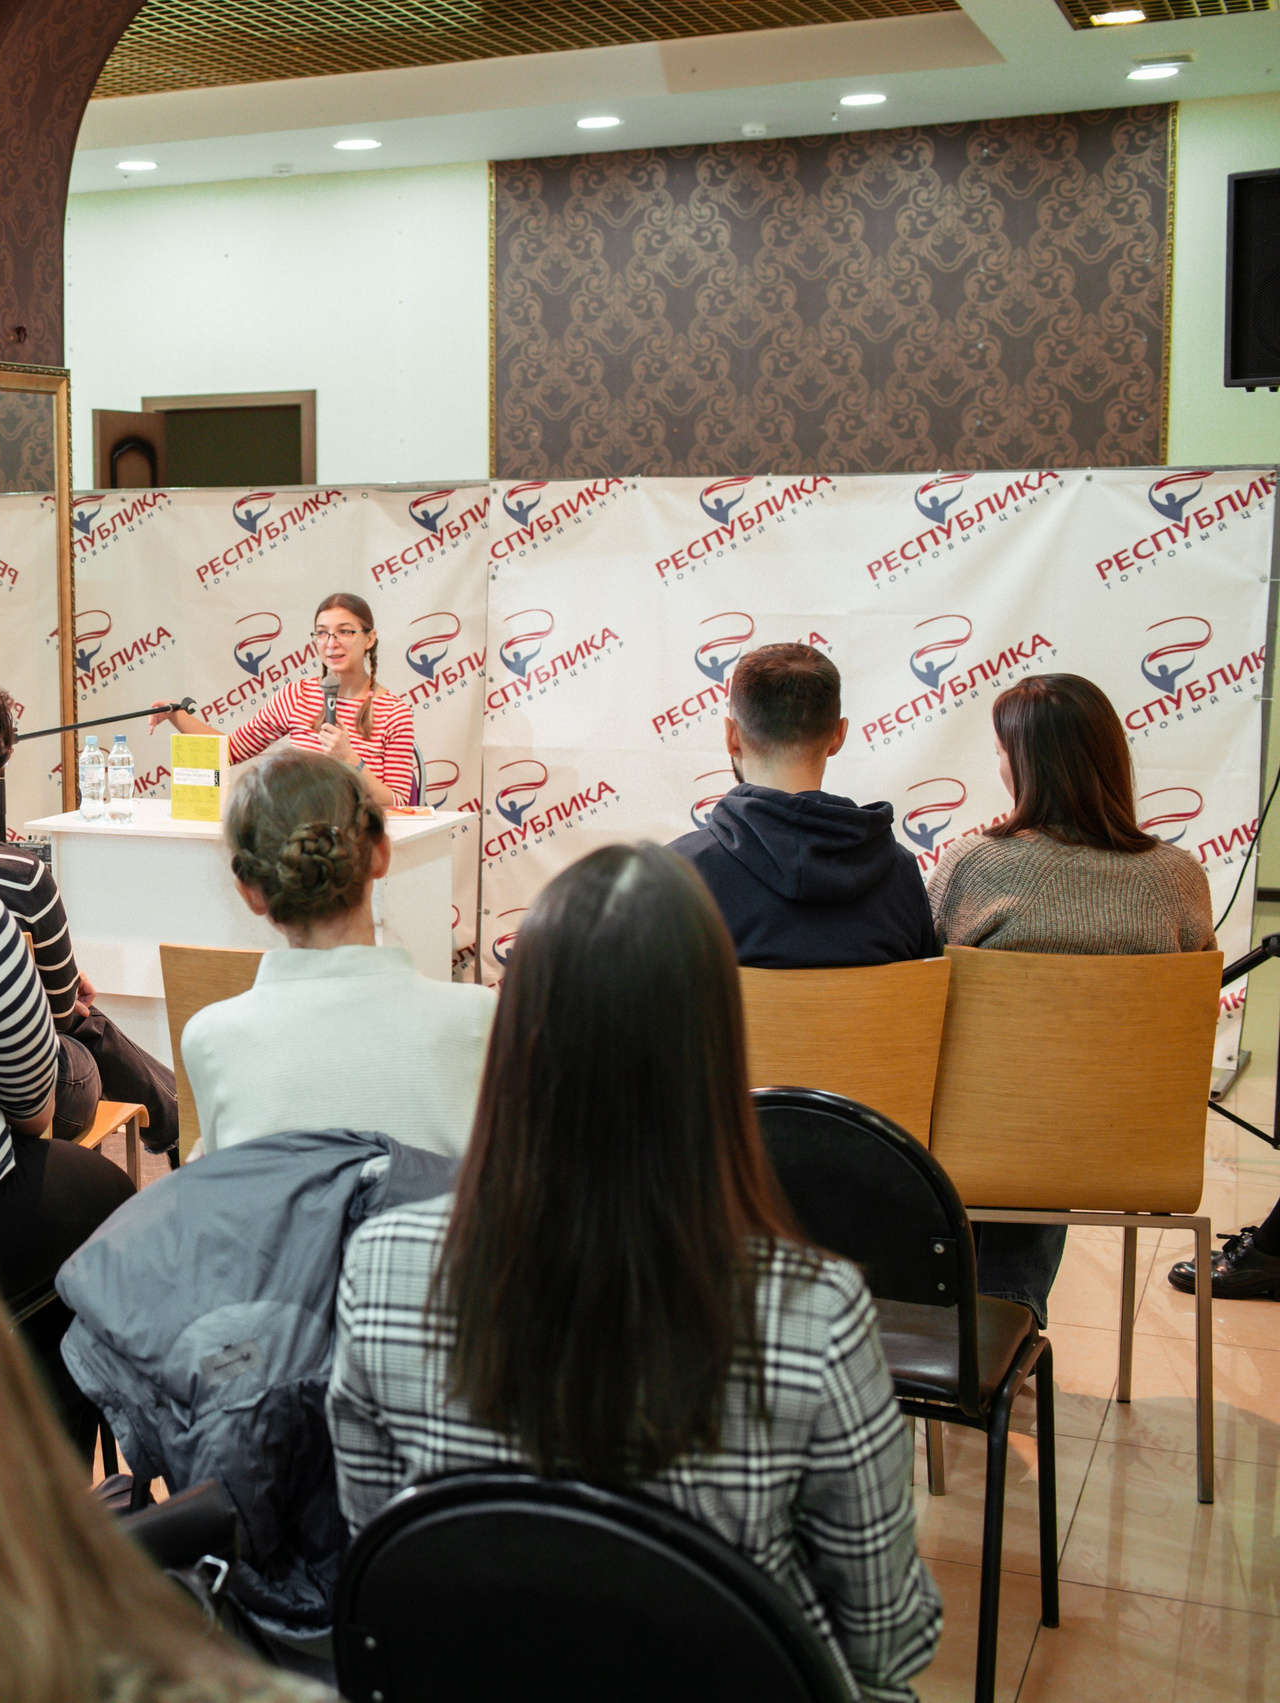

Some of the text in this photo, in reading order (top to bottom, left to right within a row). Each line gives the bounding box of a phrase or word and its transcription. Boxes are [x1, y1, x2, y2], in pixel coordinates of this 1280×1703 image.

[72, 493, 168, 558] ПУБЛИКА
[80, 500, 172, 563] ОВЫЙ ЦЕНТР
[196, 491, 342, 583] РЕСПУБЛИКА
[203, 496, 348, 591] ТОРГОВЫЙ ЦЕНТР
[371, 497, 490, 583] РЕСПУБЛИ
[378, 532, 472, 590] ТОРГОВЫЙ
[488, 479, 623, 566] СПУБЛИКА
[493, 485, 629, 571] РГОВЫЙ ЦЕНТР
[655, 476, 832, 579] РЕСПУБЛИКА
[663, 484, 838, 588] ТОРГОВЫЙ ЦЕНТР
[866, 471, 1059, 581] РЕСПУБЛИКА
[875, 480, 1065, 590] ТОРГОВЫЙ ЦЕНТР
[1095, 472, 1276, 581] РЕСПУБЛИК
[1104, 522, 1227, 590] ТОРГОВЫЙ
[81, 639, 176, 700] ОВЫЙ ЦЕНТР
[200, 641, 319, 723] РЕСПУБЛИ
[209, 677, 291, 727] ОРГОВЫЙ
[423, 680, 467, 709] ОВЫЙ
[483, 627, 619, 715] СПУБЛИКА
[490, 641, 624, 722] РГОВЫЙ ЦЕНТР
[861, 633, 1053, 743] РЕСПУБЛИКА
[870, 649, 1058, 752] ТОРГОВЫЙ ЦЕНТР
[1125, 644, 1266, 730] СПУБЛИК
[660, 702, 730, 743] ТОРГО
[1128, 694, 1219, 744] РГОВЫЙ
[481, 781, 616, 863] СПУБЛИКА
[488, 828, 556, 869] РГОВЫЙ
[565, 795, 621, 828] ЦЕНТР
